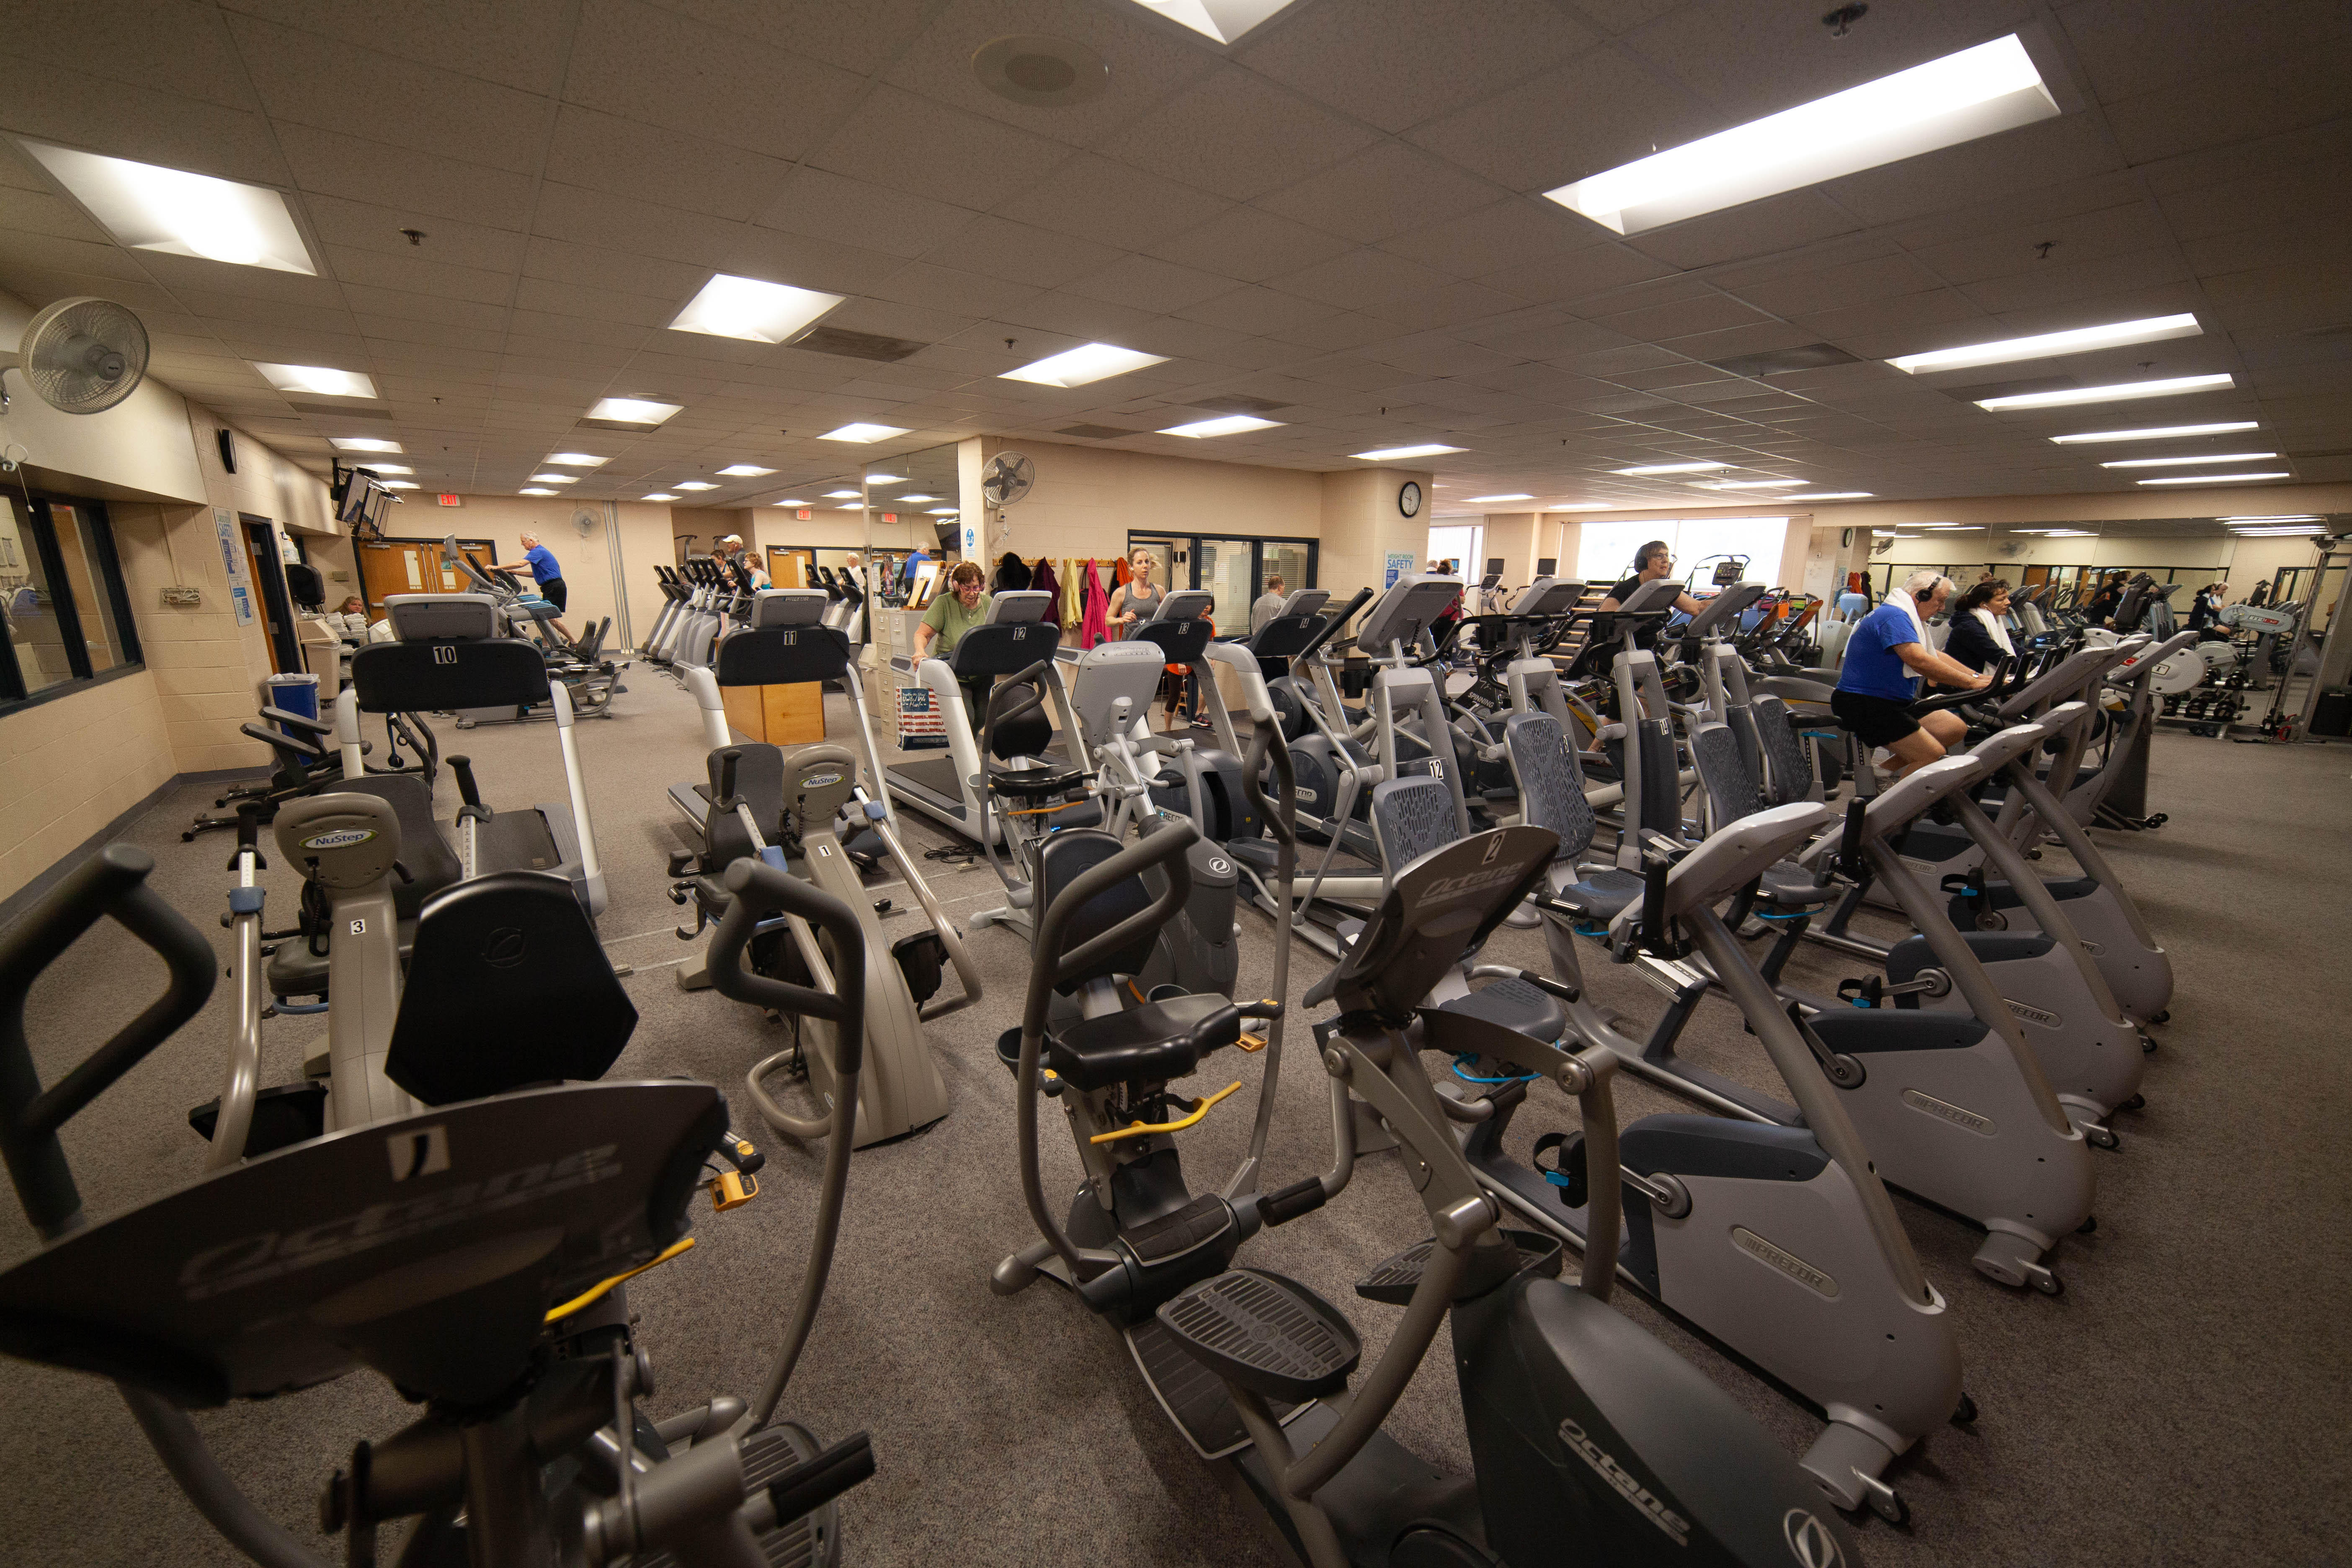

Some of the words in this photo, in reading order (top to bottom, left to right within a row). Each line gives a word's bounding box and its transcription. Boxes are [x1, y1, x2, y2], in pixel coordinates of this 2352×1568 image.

[441, 495, 456, 505] EXIT
[799, 510, 810, 519] EXIT
[1387, 559, 1413, 569] SAFETY
[1180, 624, 1189, 633] 13
[1302, 619, 1308, 628] 14
[785, 632, 795, 645] 11
[1015, 628, 1025, 640] 12
[435, 647, 455, 663] 10
[1468, 692, 1494, 707] SPINNING
[1661, 720, 1667, 734] 14
[1431, 761, 1443, 779] 12
[808, 777, 837, 785] NuStep
[316, 833, 364, 845] NuStep
[822, 846, 829, 855] 1
[1485, 834, 1503, 861] 2
[353, 921, 363, 933] 3
[1755, 1242, 1823, 1287] PRECOR
[1561, 1418, 1690, 1532] Octane
